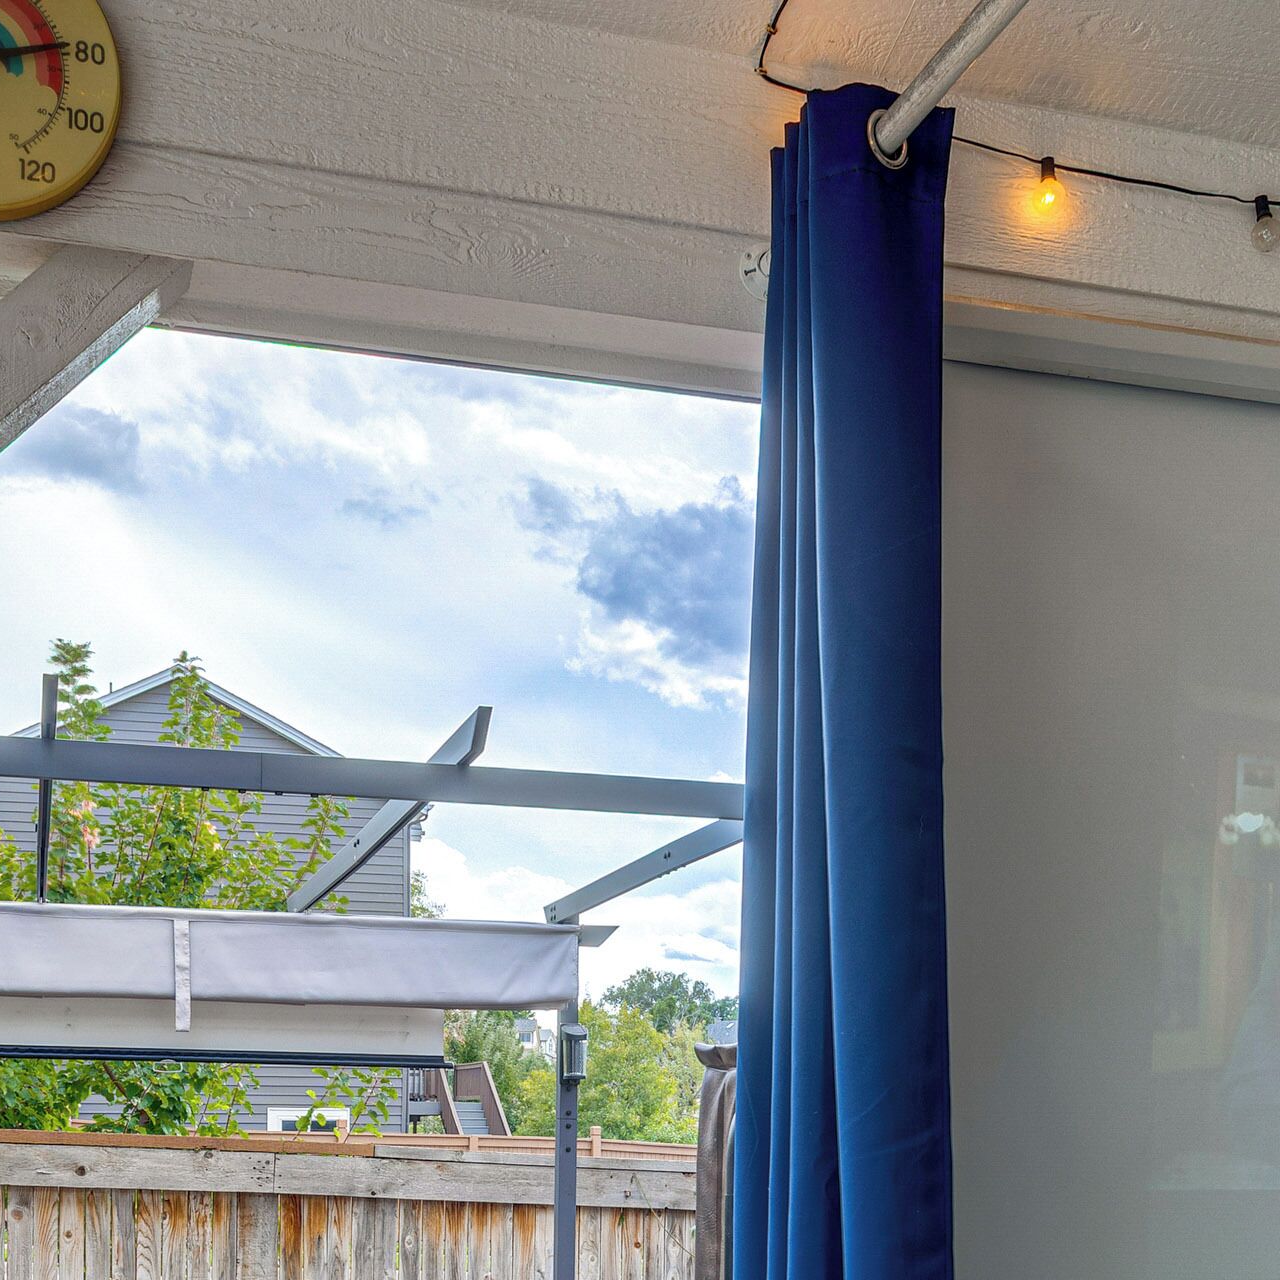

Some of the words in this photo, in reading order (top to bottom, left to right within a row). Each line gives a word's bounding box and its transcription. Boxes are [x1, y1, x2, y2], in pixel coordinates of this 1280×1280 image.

[75, 40, 105, 65] 80
[66, 106, 104, 134] 100
[18, 158, 56, 184] 120
